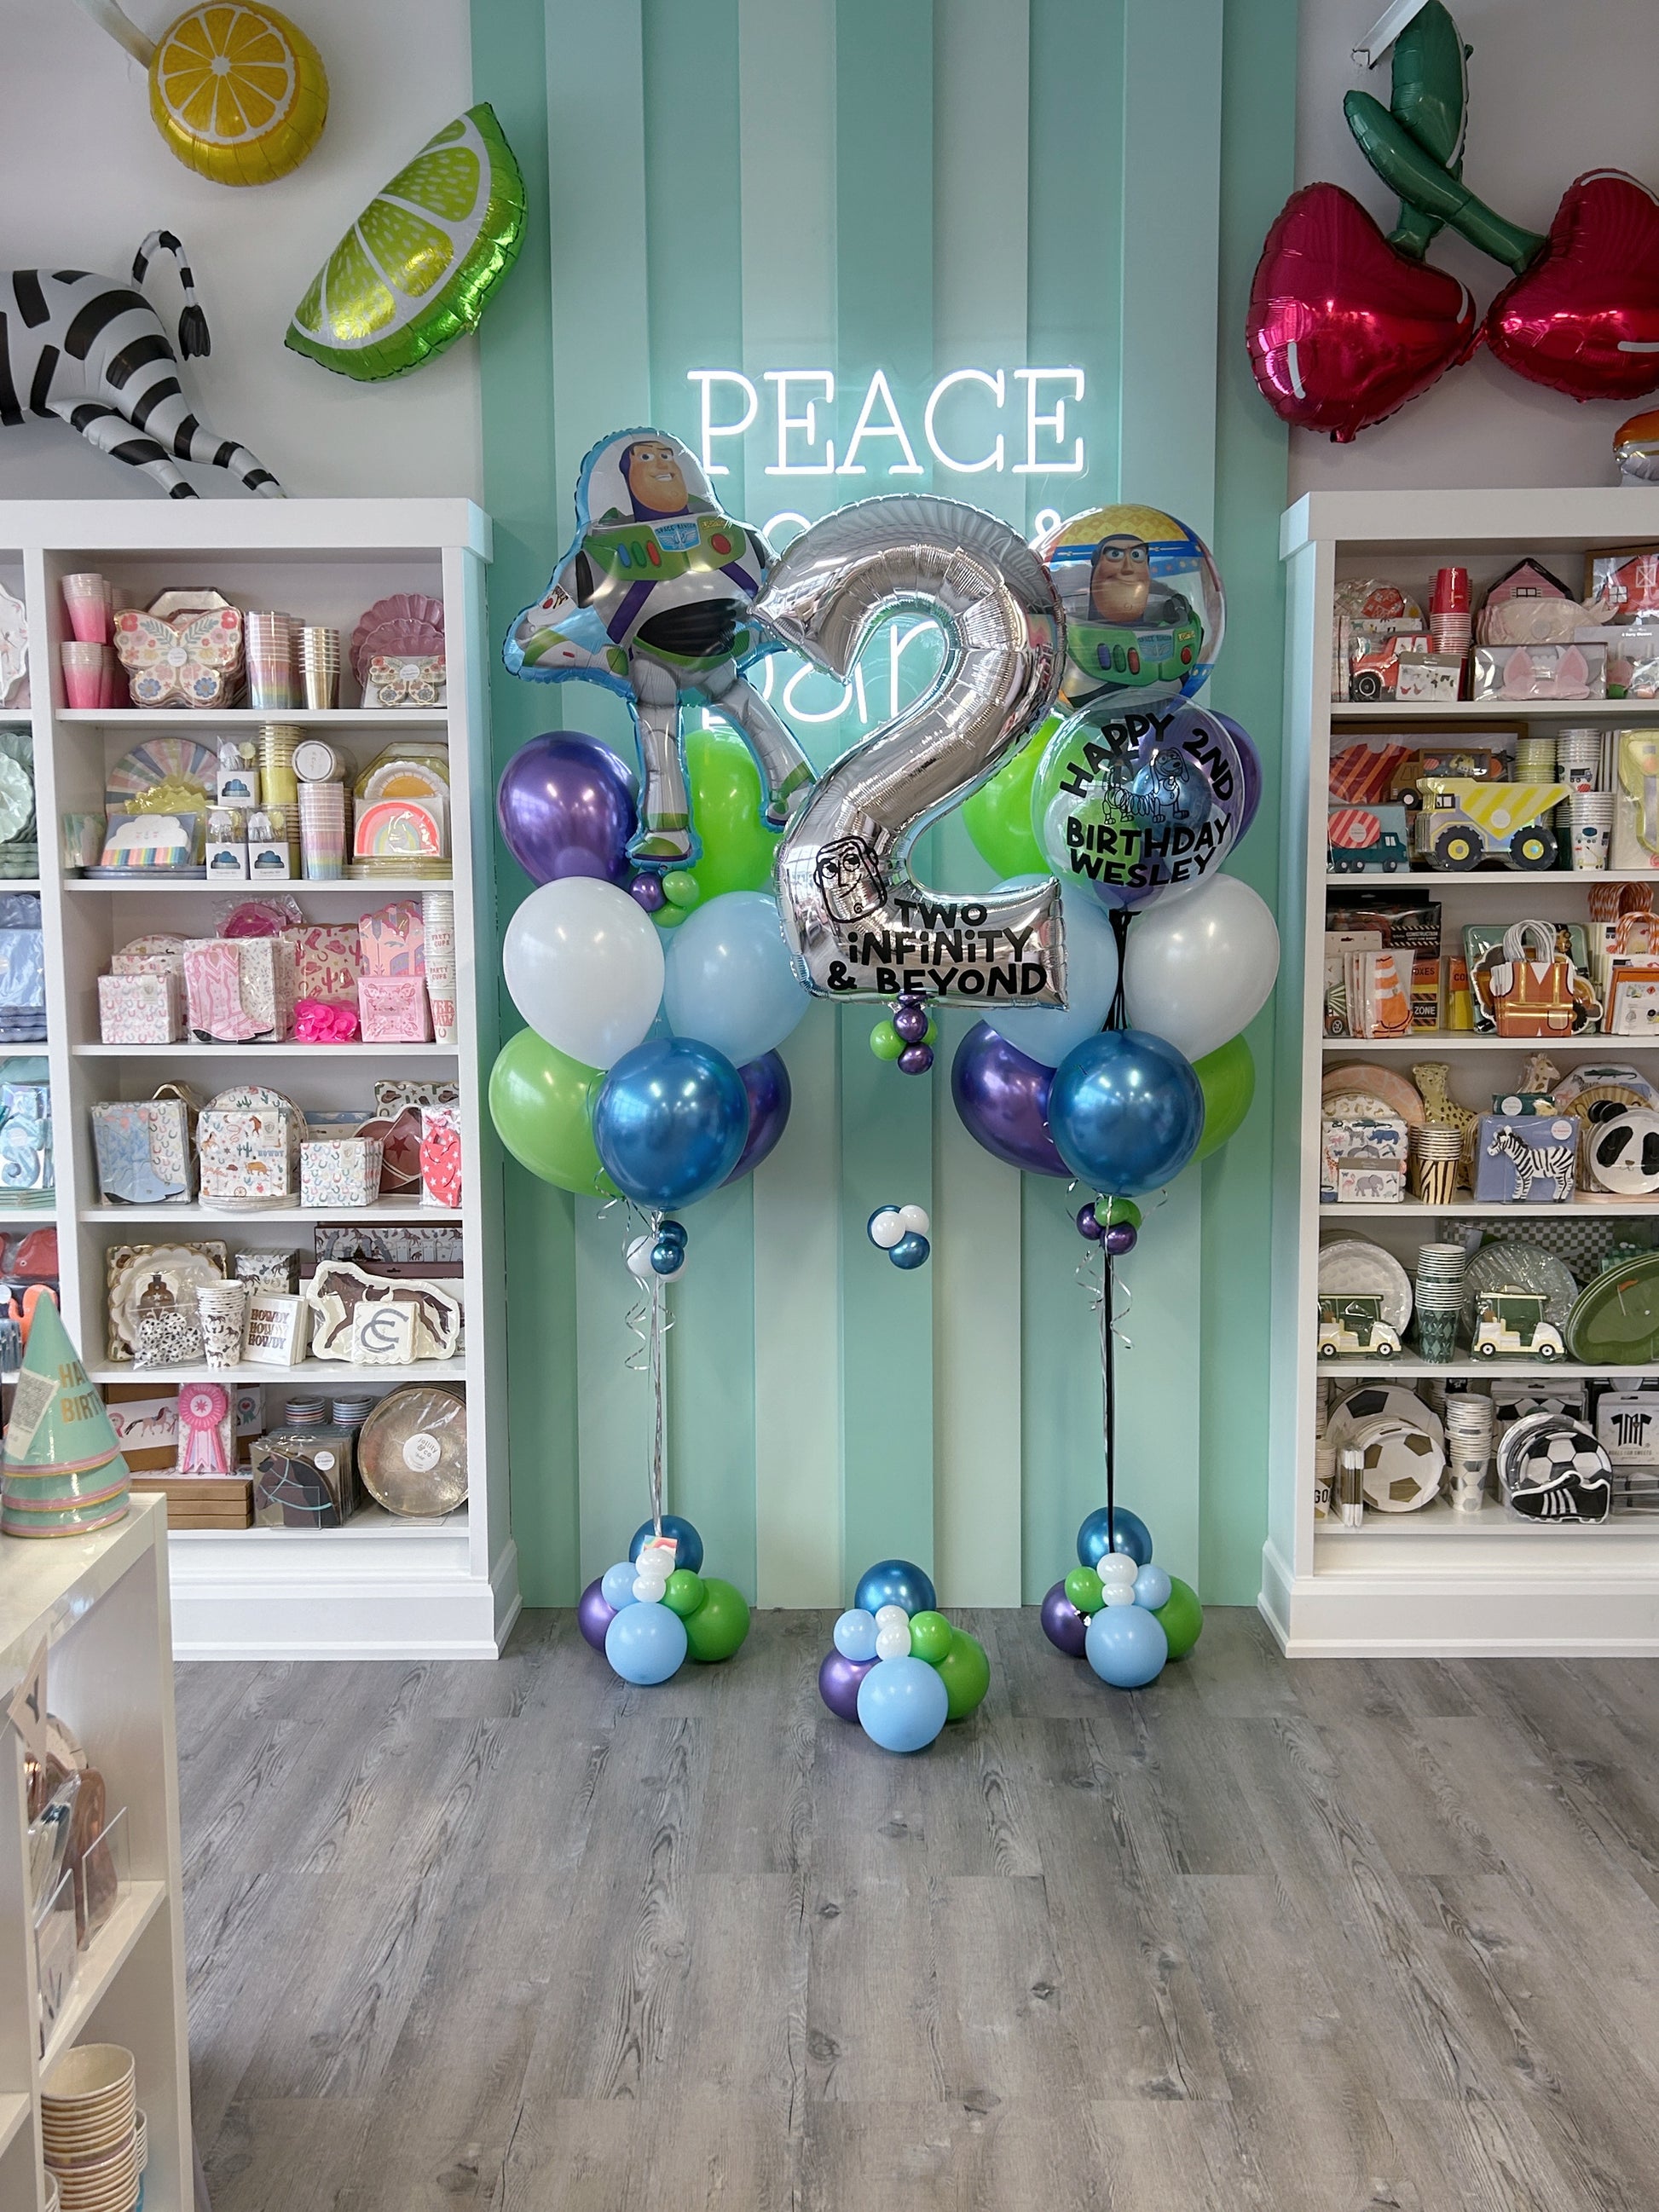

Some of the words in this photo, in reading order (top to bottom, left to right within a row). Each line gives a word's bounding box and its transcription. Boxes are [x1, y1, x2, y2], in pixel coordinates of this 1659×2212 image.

[686, 368, 1086, 476] PEACE
[752, 494, 1072, 1012] 2
[1060, 713, 1175, 799] HAPPY
[1182, 728, 1234, 801] 2ND
[1066, 812, 1232, 858] BIRTHDAY
[1070, 846, 1217, 888] WESLEY
[893, 898, 988, 930] TWO
[431, 933, 451, 941] PARTY
[827, 960, 858, 991] &
[876, 963, 1048, 996] BEYOND
[1413, 967, 1435, 976] OXES
[1413, 1006, 1436, 1015] ZONE
[251, 1308, 290, 1324] HOWDY
[248, 1334, 286, 1349] HOWDY
[58, 1360, 87, 1389] HA
[61, 1390, 107, 1424] BIRT
[1315, 1488, 1330, 1504] GO
